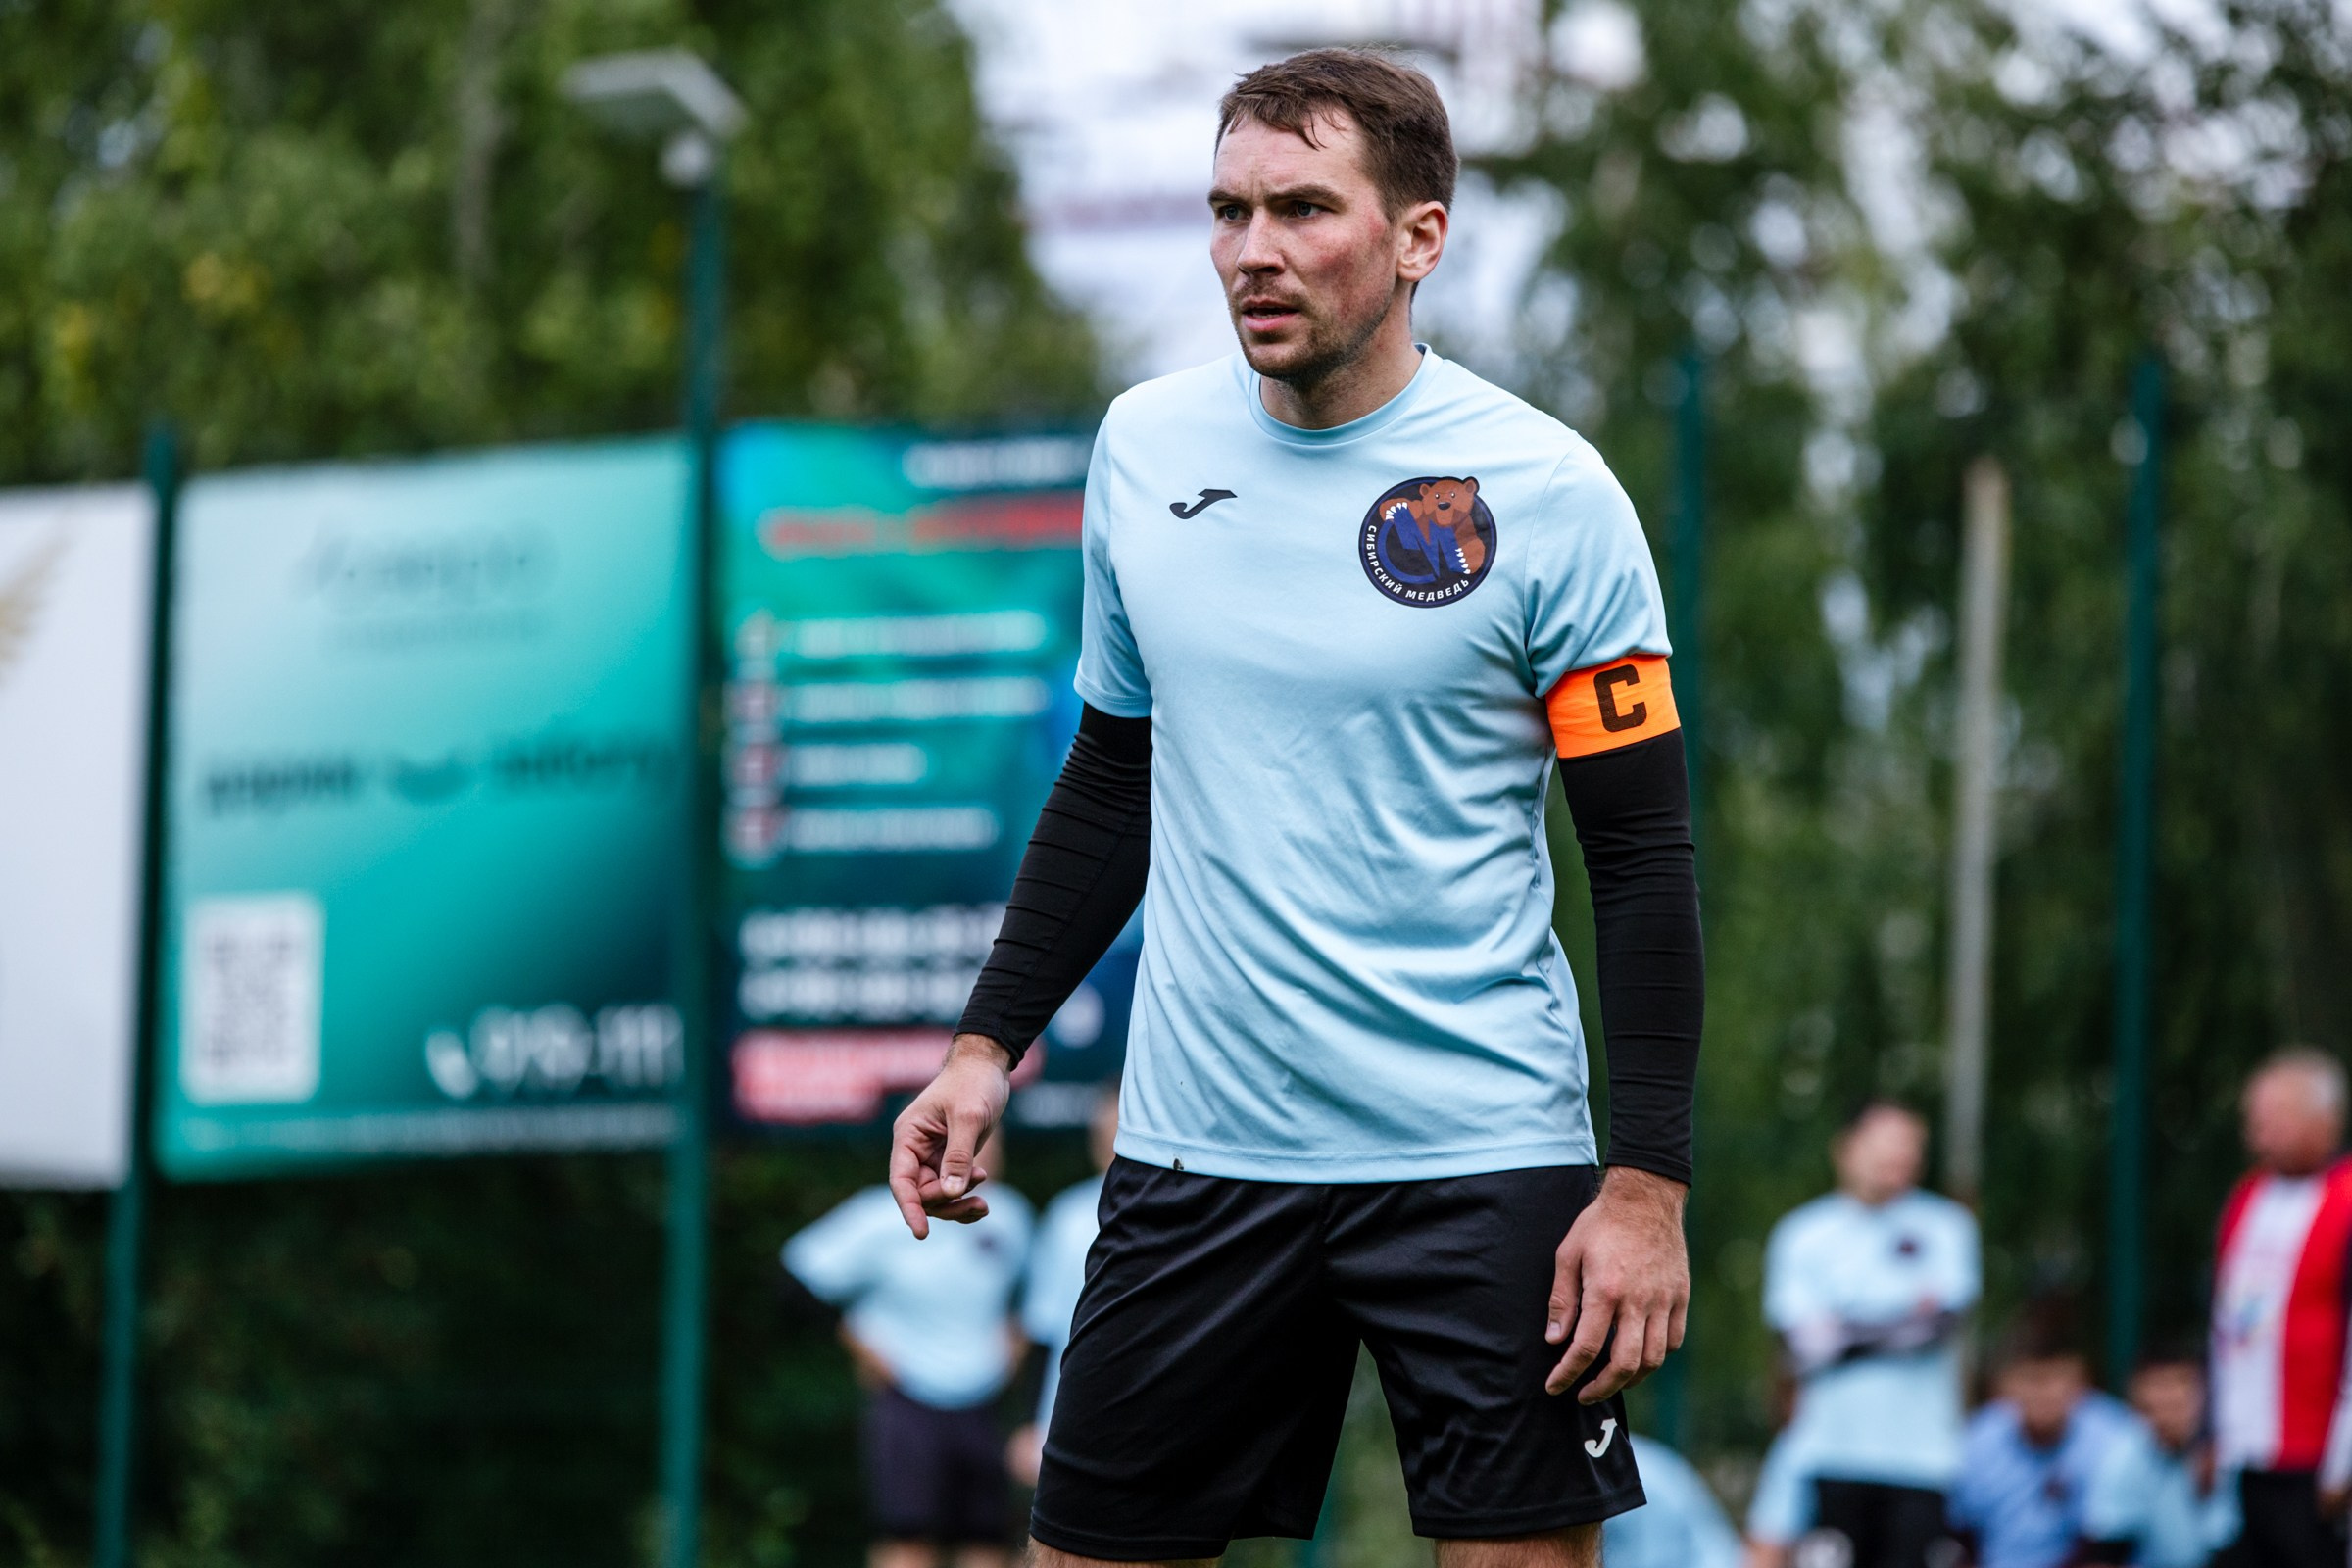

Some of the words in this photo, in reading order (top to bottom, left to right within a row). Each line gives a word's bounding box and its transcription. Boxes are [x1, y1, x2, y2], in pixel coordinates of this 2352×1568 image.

[1366, 525, 1403, 594] СИБИРСКИЙ
[1405, 578, 1469, 602] МЕДВЕДЬ
[1593, 664, 1647, 733] C
